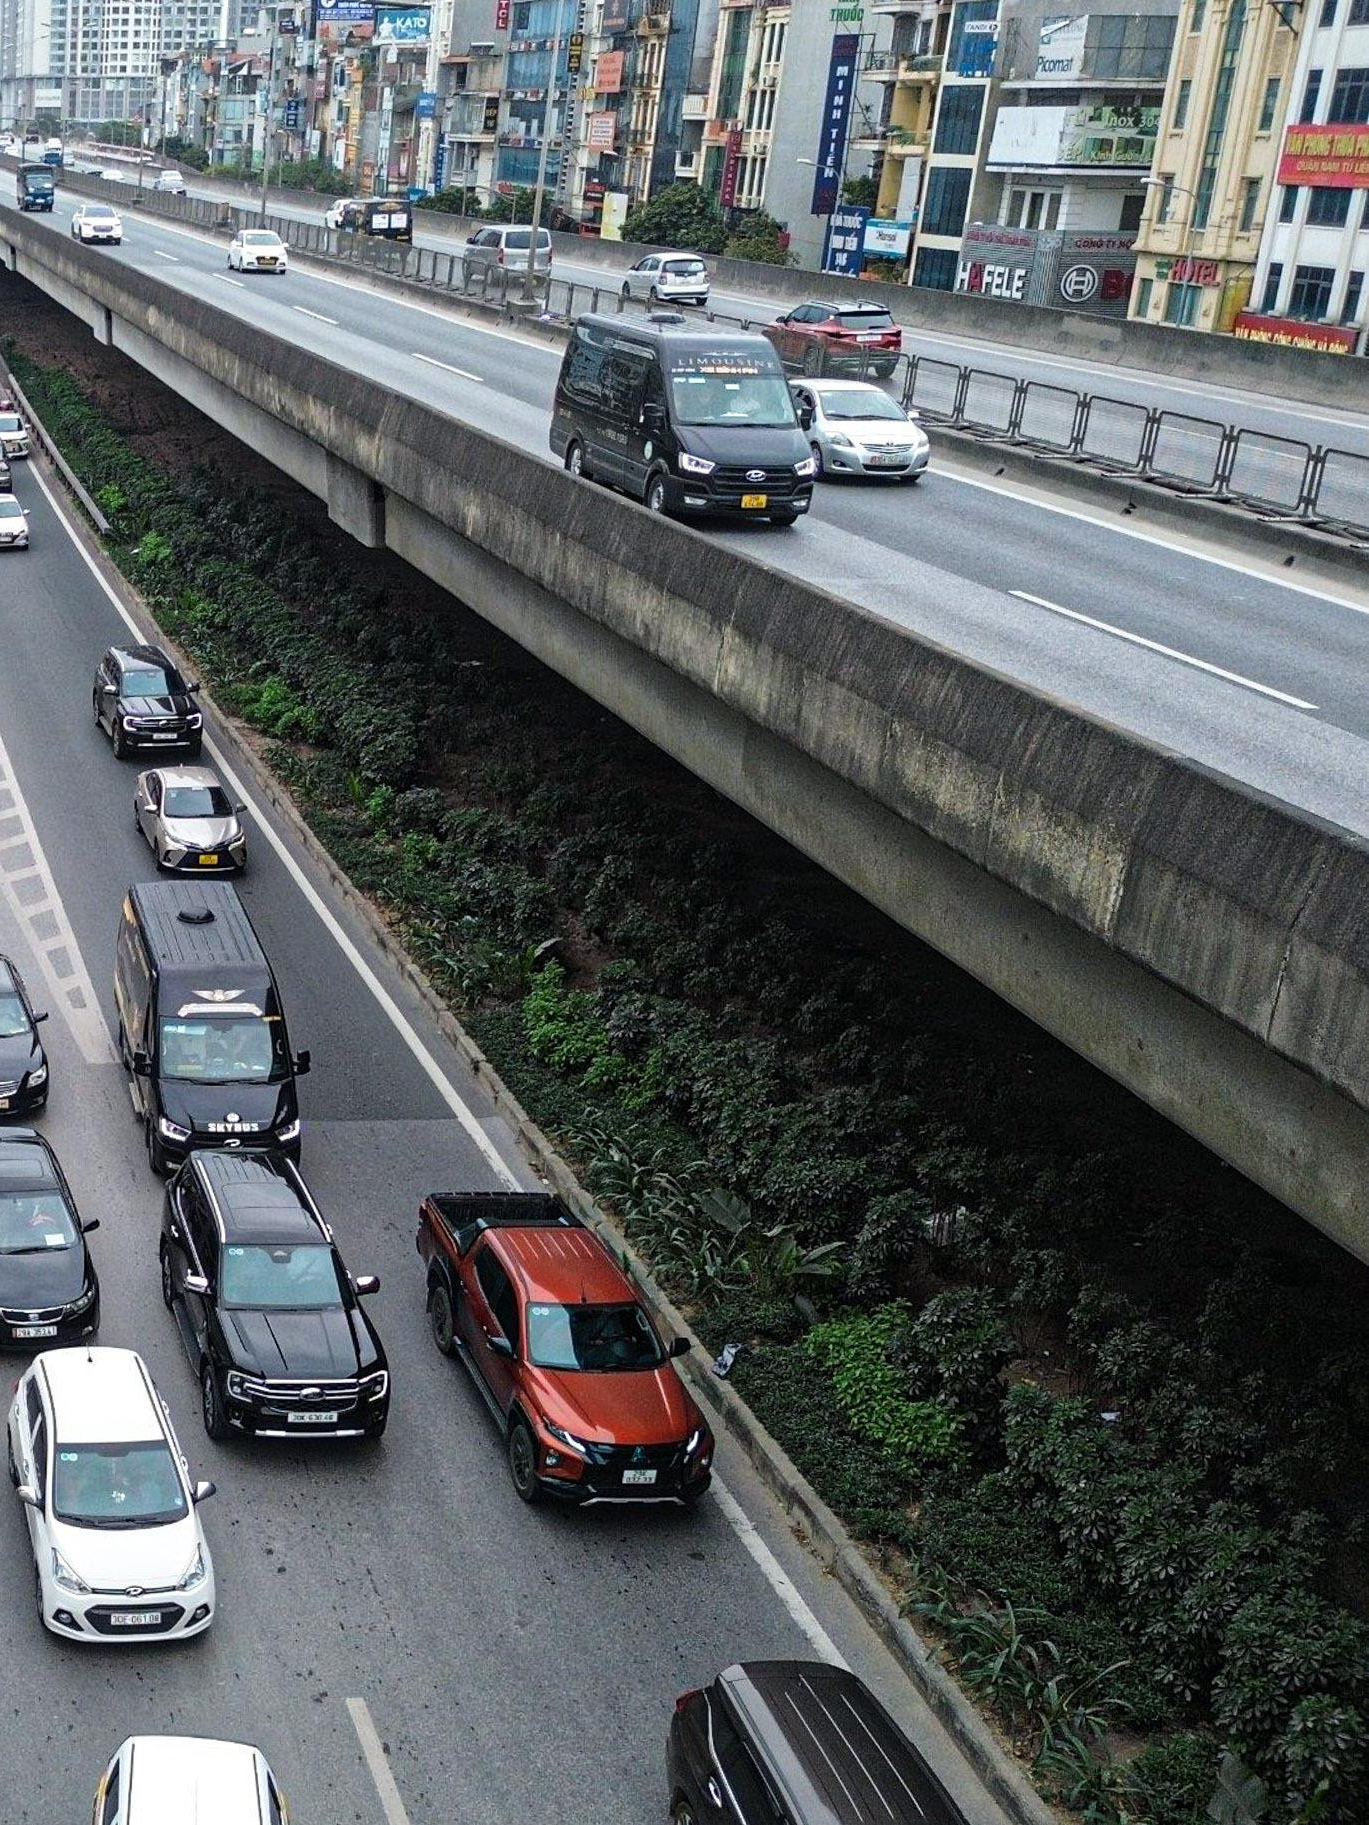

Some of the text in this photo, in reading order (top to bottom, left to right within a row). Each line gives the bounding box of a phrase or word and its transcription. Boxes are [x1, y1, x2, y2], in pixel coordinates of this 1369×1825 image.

[396, 17, 428, 28] KATO
[1037, 56, 1073, 72] Picomat
[831, 66, 850, 119] MINH
[1171, 258, 1220, 285] HOTEL
[678, 357, 774, 369] LIMOUSINE
[207, 1122, 259, 1133] SKYBUS
